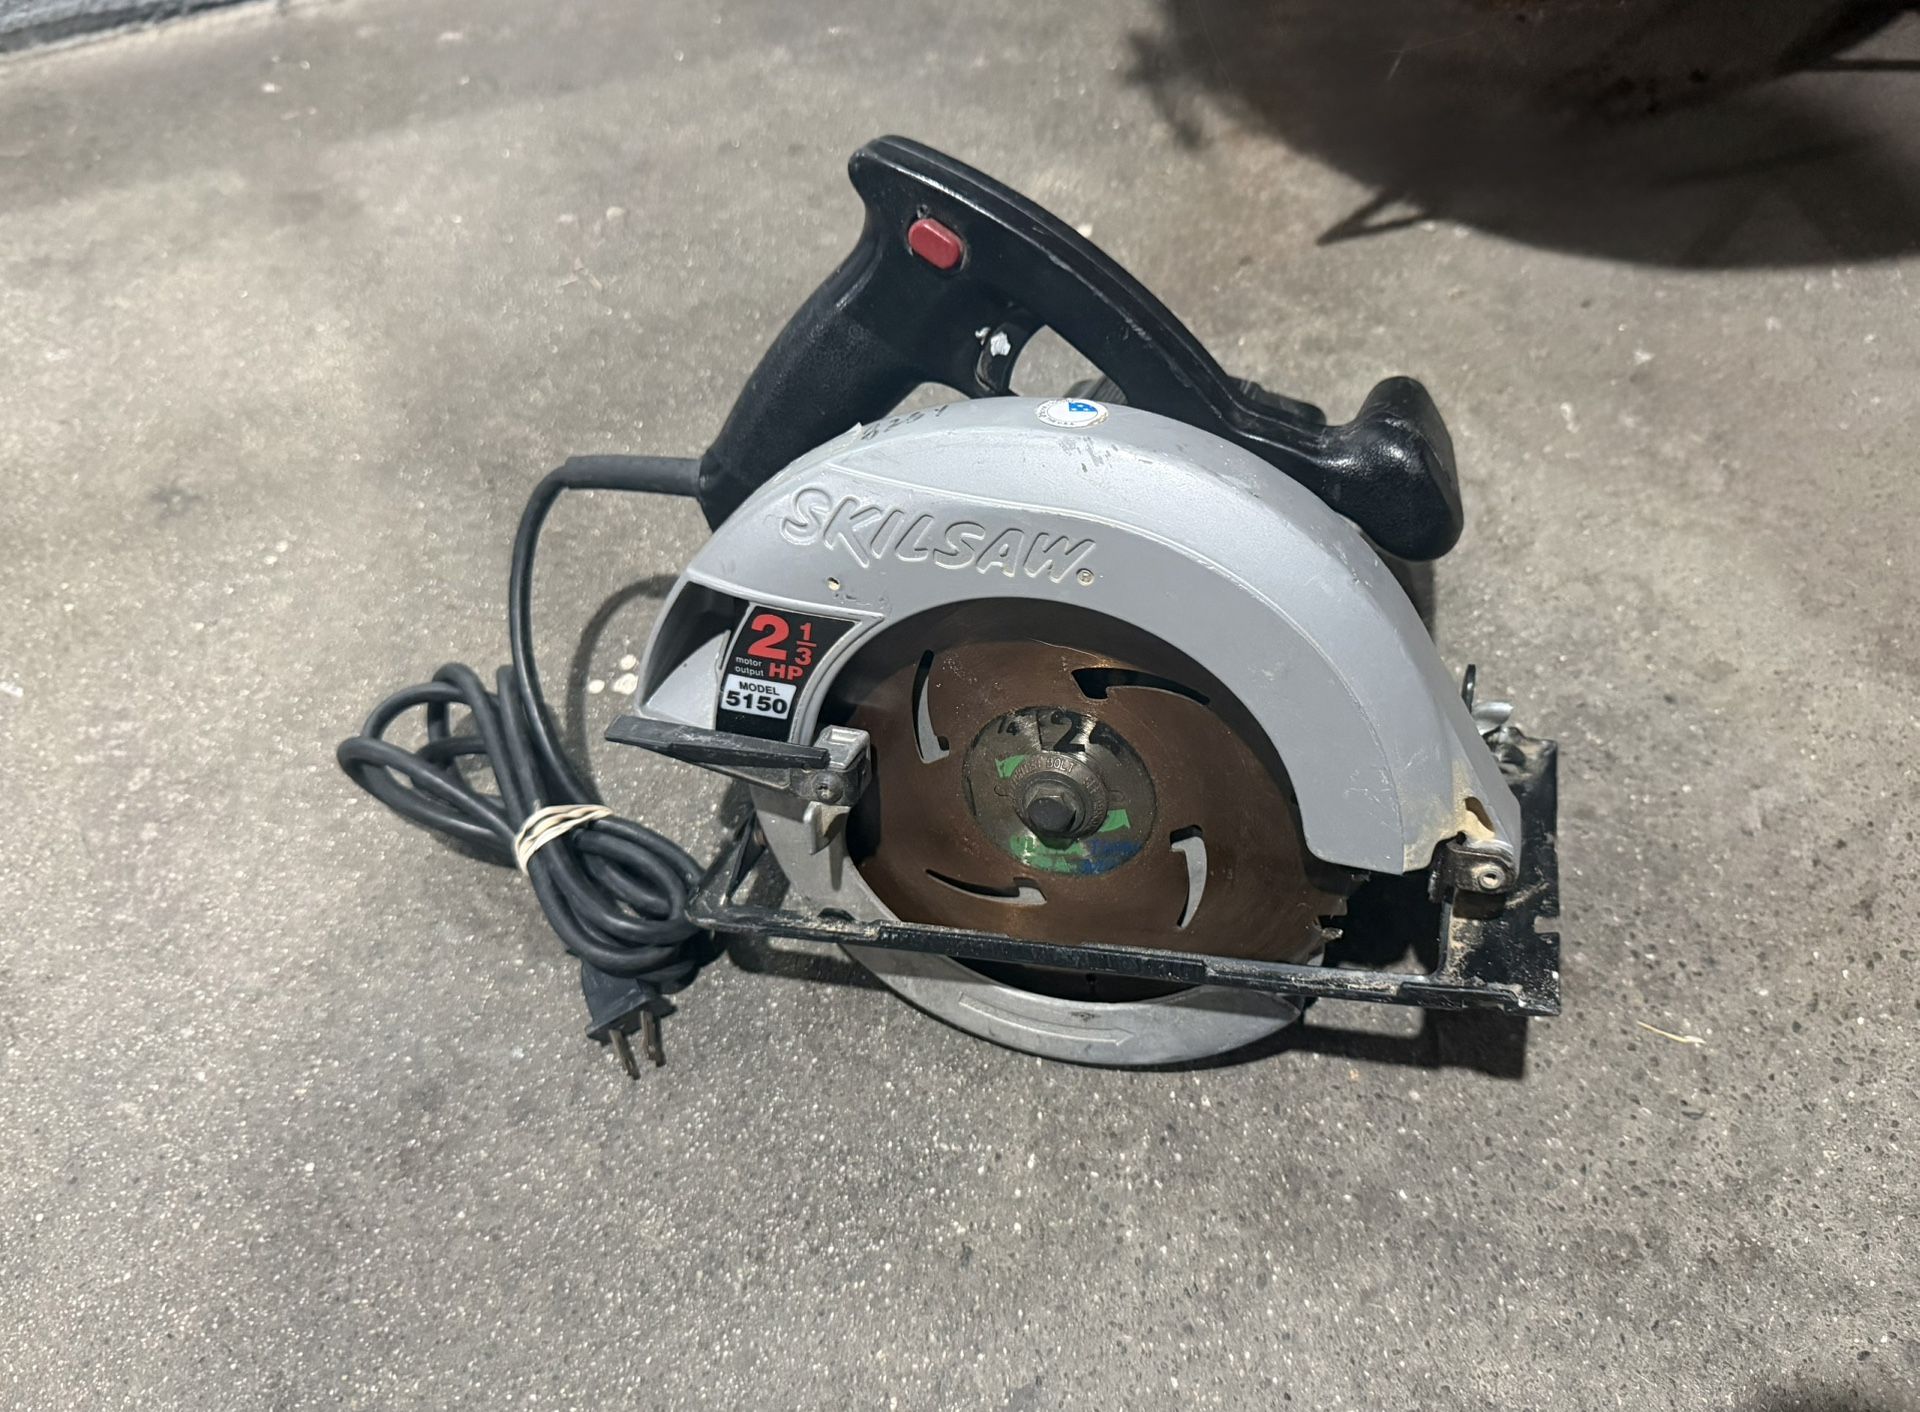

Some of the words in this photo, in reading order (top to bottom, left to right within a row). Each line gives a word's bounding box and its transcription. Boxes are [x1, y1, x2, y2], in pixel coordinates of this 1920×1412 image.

[780, 486, 1095, 584] SKILSAW
[748, 614, 790, 661] 2
[735, 656, 762, 667] motor
[735, 666, 765, 677] output
[769, 662, 804, 680] HP
[739, 681, 781, 696] MODEL
[725, 690, 788, 714] 5150
